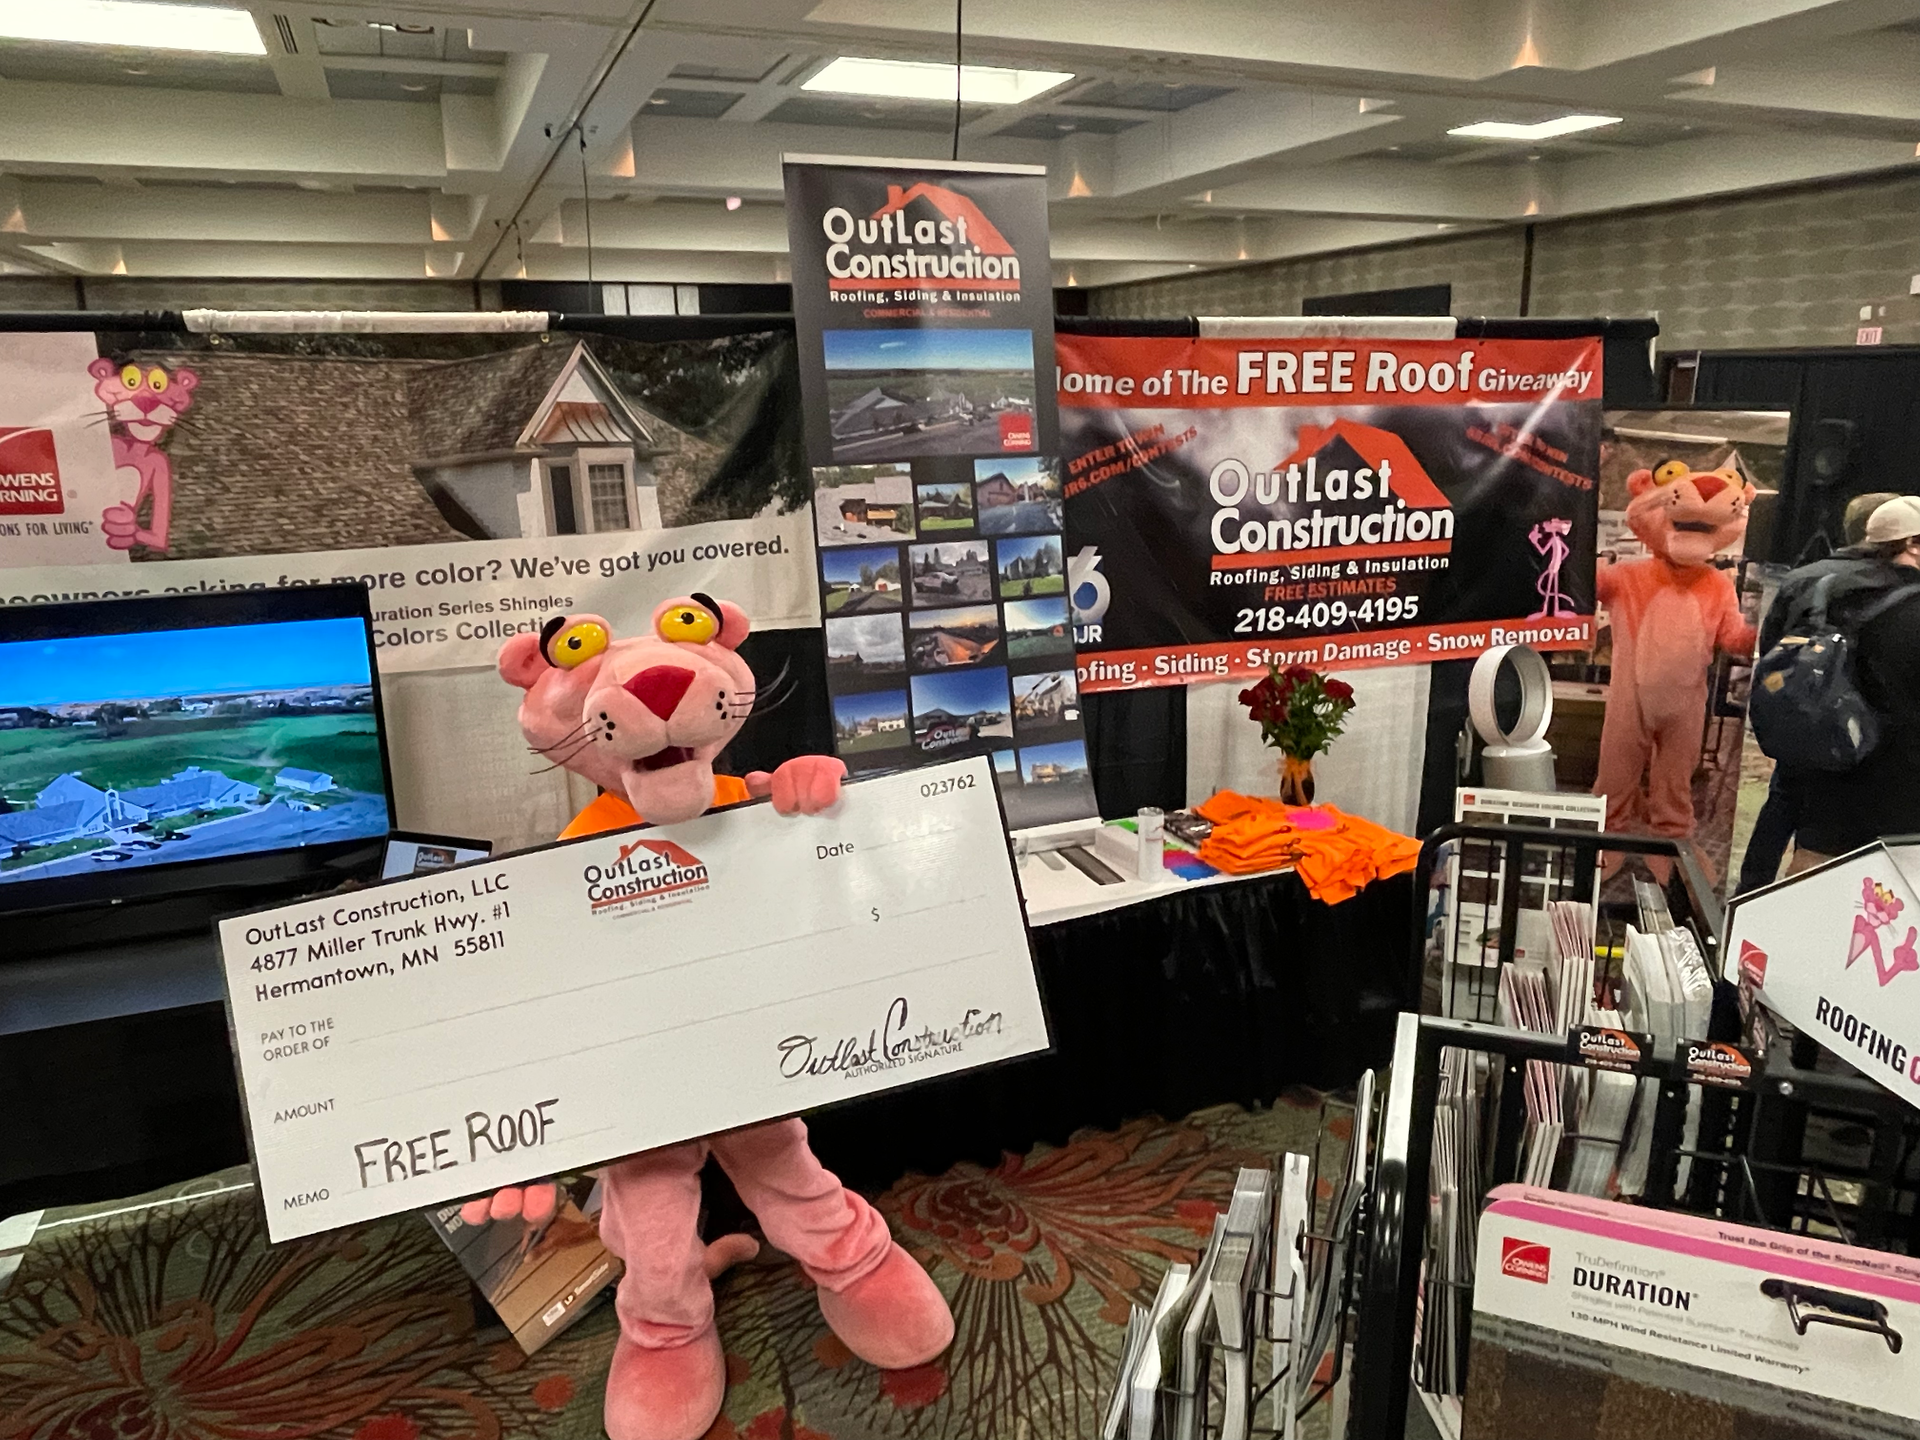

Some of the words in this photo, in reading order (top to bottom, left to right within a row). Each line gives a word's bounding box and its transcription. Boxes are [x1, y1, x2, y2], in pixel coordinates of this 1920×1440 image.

[823, 207, 967, 244] OutLast
[826, 243, 1020, 280] Construction
[830, 290, 889, 304] Roofing,
[894, 290, 938, 303] Siding
[942, 290, 952, 301] &
[956, 290, 1021, 302] Insulation
[1142, 369, 1173, 396] of
[1177, 369, 1229, 395] The
[1236, 350, 1355, 394] FREE
[1365, 350, 1475, 393] Roof
[1478, 368, 1593, 394] Giveaway
[1067, 445, 1116, 475] ENTER
[0, 472, 56, 487] WENS
[1209, 457, 1392, 507] OutLast
[25, 522, 48, 536] FOR
[1211, 498, 1455, 554] Construction
[416, 559, 502, 587] color?
[511, 555, 590, 580] We've
[600, 553, 640, 577] got
[647, 547, 685, 572] you
[692, 535, 790, 561] covered.
[1209, 568, 1284, 586] Roofing,
[1290, 562, 1341, 580] Siding
[1346, 561, 1359, 575] &
[1365, 556, 1450, 573] Insulation
[1264, 583, 1304, 602] FREE
[1307, 577, 1397, 598] ESTIMATES
[438, 600, 494, 616] Series
[499, 595, 574, 613] Shingles
[1234, 595, 1420, 633] 218-409-4195
[373, 627, 448, 648] Colors
[1072, 624, 1103, 643] JR
[1154, 652, 1229, 676] Siding
[1246, 648, 1318, 668] Storm
[1323, 638, 1411, 662] Damage
[1428, 632, 1486, 652] Snow
[1491, 623, 1590, 646] Removal
[919, 773, 976, 799] 023762
[816, 839, 855, 860] Date
[584, 852, 671, 883] OutLast
[587, 865, 708, 902] Construction
[245, 914, 326, 945] OutLast
[333, 885, 465, 927] Construction,
[471, 873, 510, 897] LLC
[870, 906, 880, 922] $
[250, 947, 298, 974] 4877
[307, 933, 366, 962] Miller
[372, 920, 427, 948] Trunk
[434, 908, 485, 936] Hwy.
[492, 902, 511, 920] #1
[255, 961, 395, 1002] Hermantown,
[401, 946, 439, 970] MN
[453, 930, 505, 957] 55811
[260, 1028, 286, 1045] PAY
[288, 1023, 307, 1037] TO
[309, 1017, 334, 1032] THE
[1580, 1032, 1625, 1046] OutLast
[1815, 995, 1907, 1074] ROOFING
[263, 1042, 309, 1062] ORDER
[312, 1035, 331, 1050] OF
[844, 1057, 906, 1080] AUTHORIZED
[907, 1041, 964, 1065] SIGNATURE
[1579, 1041, 1641, 1056] Construction
[1689, 1047, 1735, 1062] OutLast
[1688, 1056, 1751, 1073] Construction
[273, 1098, 336, 1124] AMOUNT
[353, 1128, 458, 1188] FREE
[465, 1098, 560, 1162] ROOF
[283, 1188, 330, 1210] MEMO
[1718, 1231, 1745, 1244] Trust
[1748, 1237, 1767, 1248] the
[1769, 1241, 1794, 1254] Grip
[1796, 1247, 1810, 1256] of
[1812, 1250, 1831, 1261] the
[1505, 1264, 1547, 1280] CORNING
[1512, 1257, 1548, 1272] OWENS
[1571, 1311, 1619, 1328] 130-MPH
[1621, 1323, 1647, 1335] Wind
[1649, 1329, 1708, 1349] Resistance
[1710, 1343, 1752, 1360] Limited
